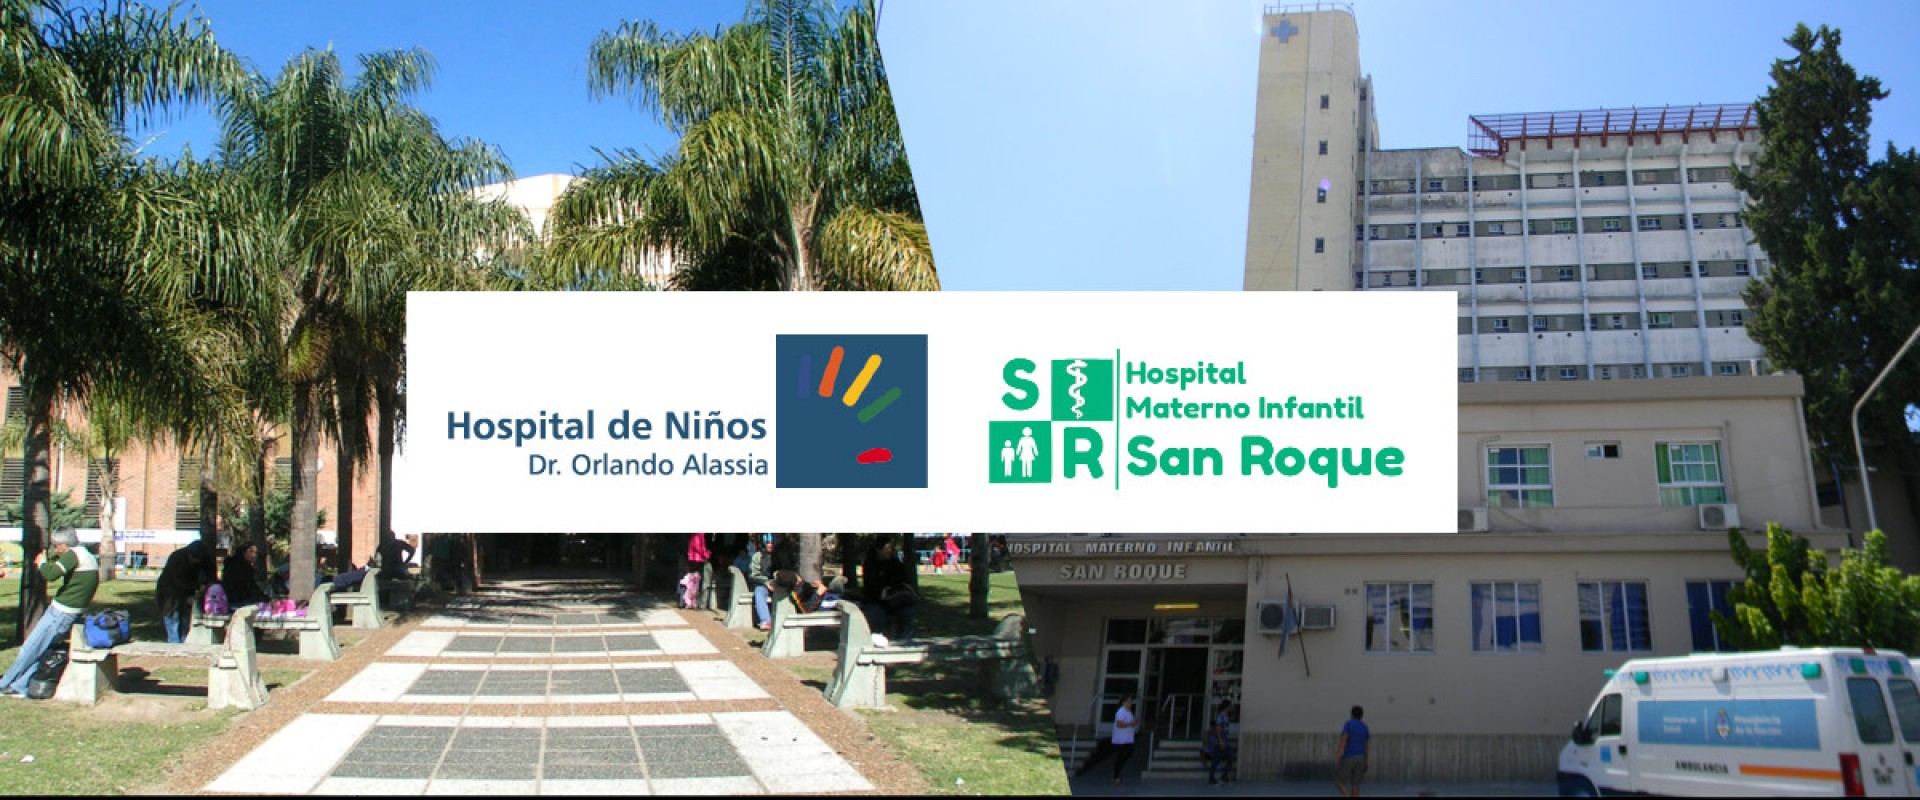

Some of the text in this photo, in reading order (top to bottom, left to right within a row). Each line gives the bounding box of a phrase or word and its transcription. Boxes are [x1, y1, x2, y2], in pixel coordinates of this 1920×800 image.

[1086, 542, 1157, 553] MATERNO
[1167, 541, 1233, 553] INFANTIL
[1060, 564, 1186, 581] SAN ROQUE
